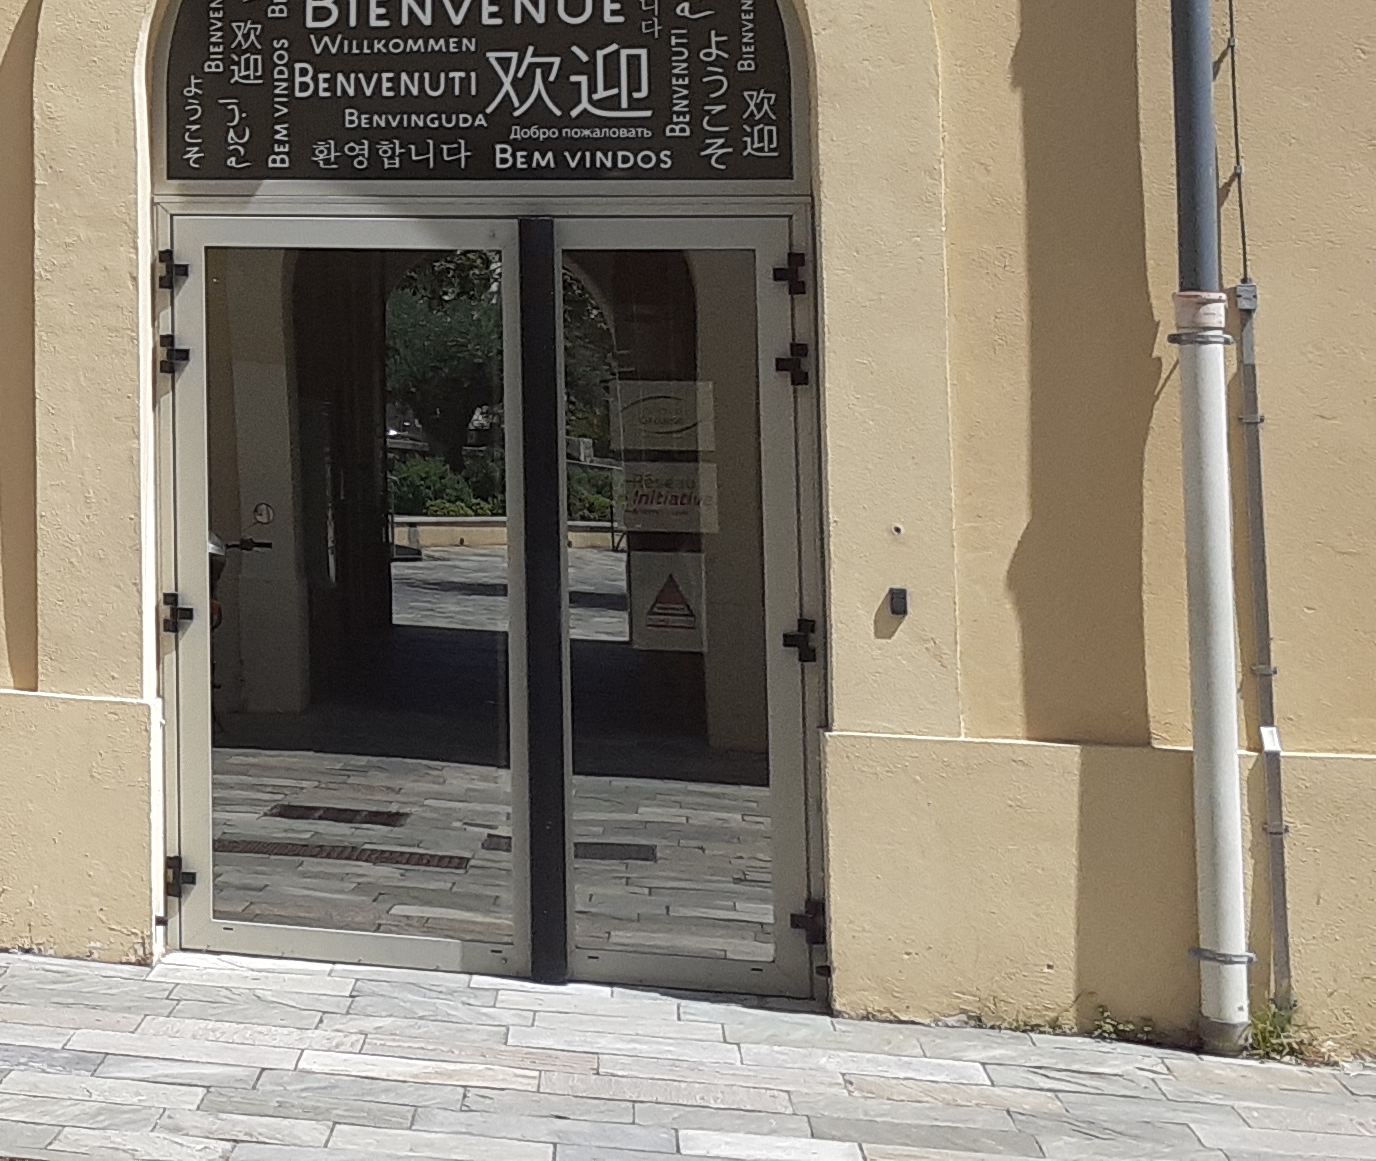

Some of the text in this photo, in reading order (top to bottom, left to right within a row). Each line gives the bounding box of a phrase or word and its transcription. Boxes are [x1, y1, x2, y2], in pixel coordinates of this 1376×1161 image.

[230, 20, 263, 84] 欢迎
[309, 34, 476, 54] WILLKOMMEN
[293, 62, 476, 98] BENVENUTI
[485, 43, 653, 118] 欢迎
[666, 29, 691, 136] BENVENUTI
[344, 109, 488, 128] BENVINGUDA
[699, 30, 733, 170] ようこそ
[183, 75, 204, 168] ようこそ
[510, 125, 652, 140] Добро пожаловать
[742, 89, 778, 157] 欢迎
[268, 124, 289, 167] BEM
[311, 139, 471, 169] 환영합니다
[495, 143, 556, 169] BEM
[633, 489, 714, 507] Initiative
